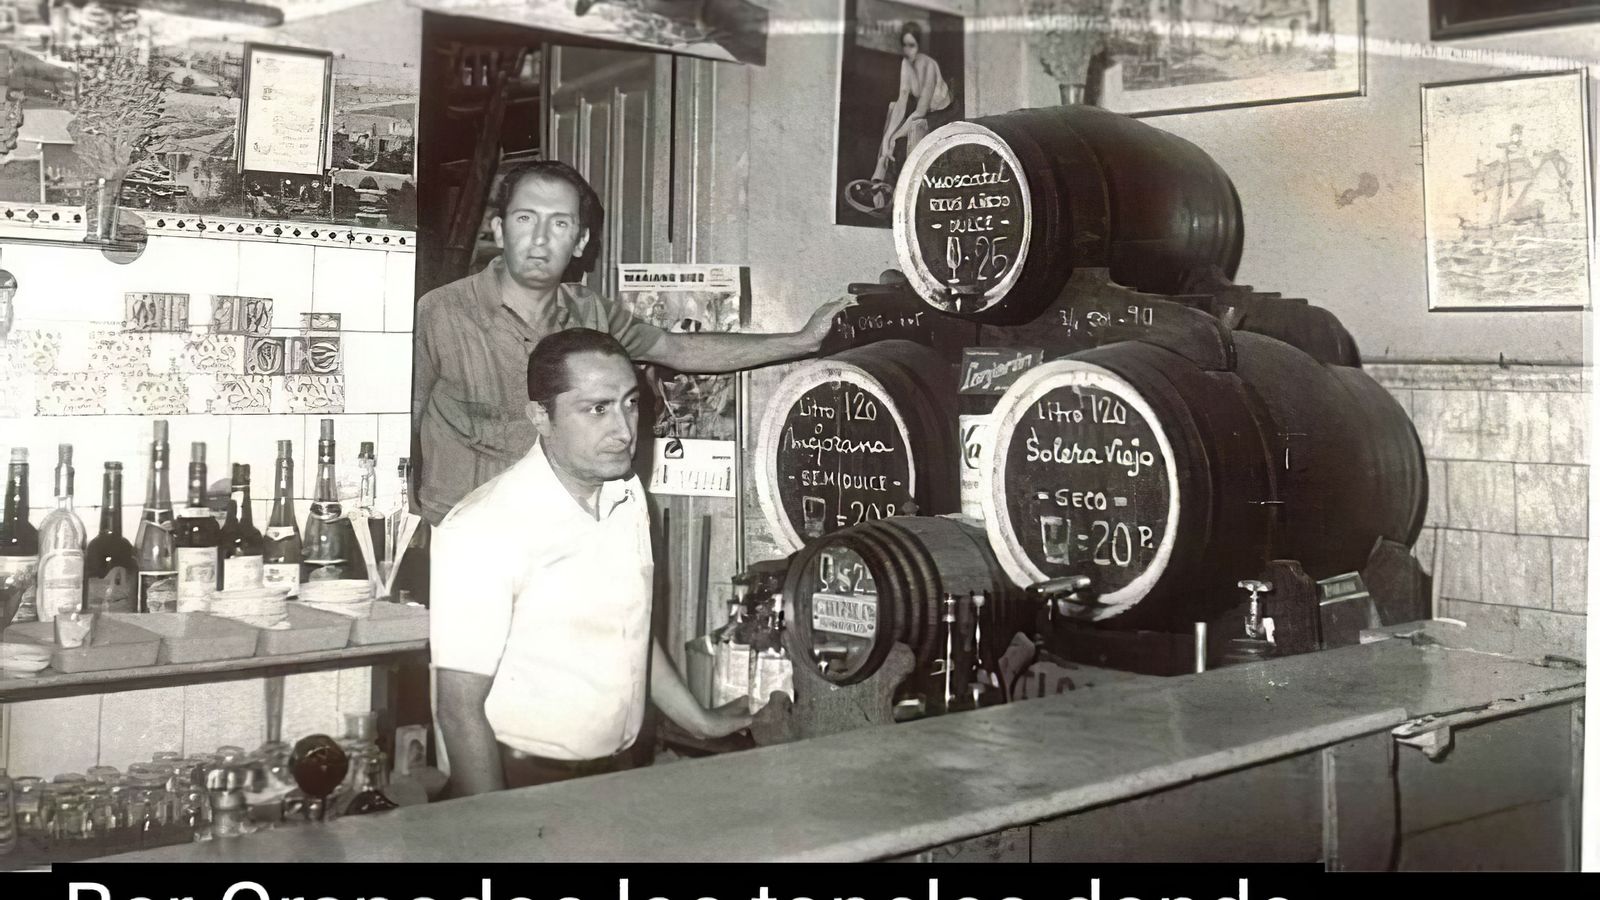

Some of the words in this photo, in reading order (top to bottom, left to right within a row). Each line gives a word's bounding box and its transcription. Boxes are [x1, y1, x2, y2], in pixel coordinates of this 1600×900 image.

[950, 215, 994, 232] DULCE
[975, 236, 1008, 280] 25
[800, 397, 834, 419] Litro
[845, 392, 877, 421] 120
[1038, 401, 1083, 423] Litro
[1091, 394, 1127, 424] 120
[1026, 428, 1104, 464] Solera
[1105, 437, 1154, 477] Viejo
[1055, 489, 1107, 510] SECO
